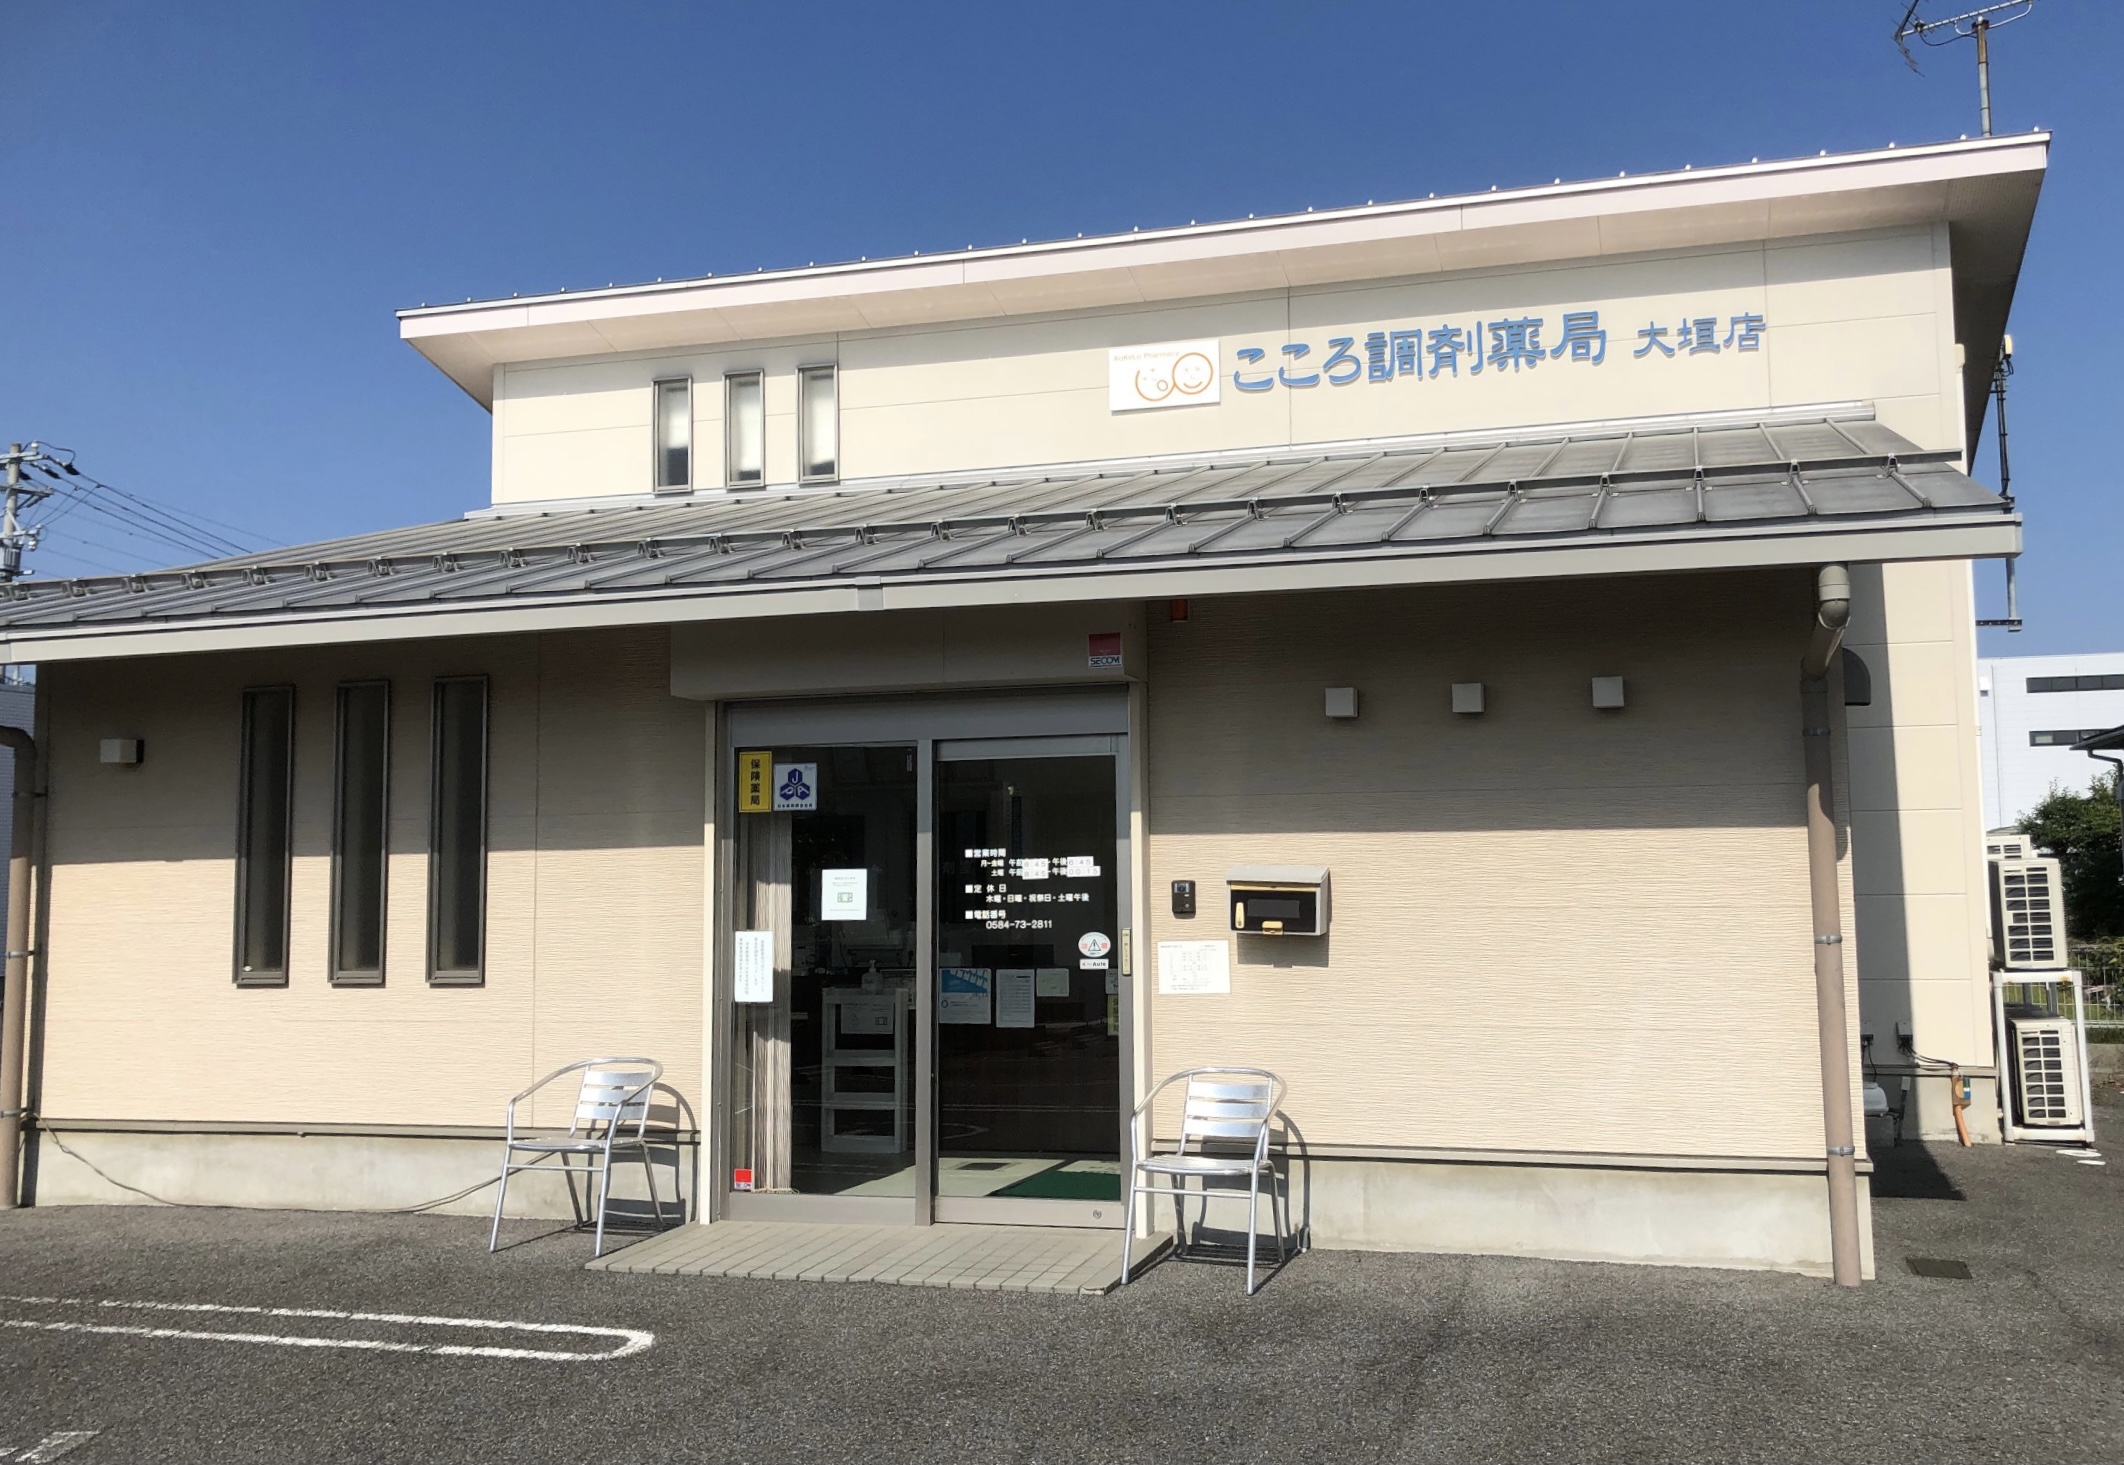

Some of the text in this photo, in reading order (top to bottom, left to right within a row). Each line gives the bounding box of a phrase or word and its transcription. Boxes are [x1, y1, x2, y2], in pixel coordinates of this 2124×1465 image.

[1143, 351, 1180, 359] Pharmacy
[1233, 310, 1766, 392] こころ調剤薬局 大垣店
[1090, 655, 1120, 666] SECOM
[750, 758, 761, 806] 保険薬局
[973, 848, 1007, 859] 営業時間
[973, 910, 1007, 920] 電話番号
[985, 920, 1053, 930] 0584-73-2811
